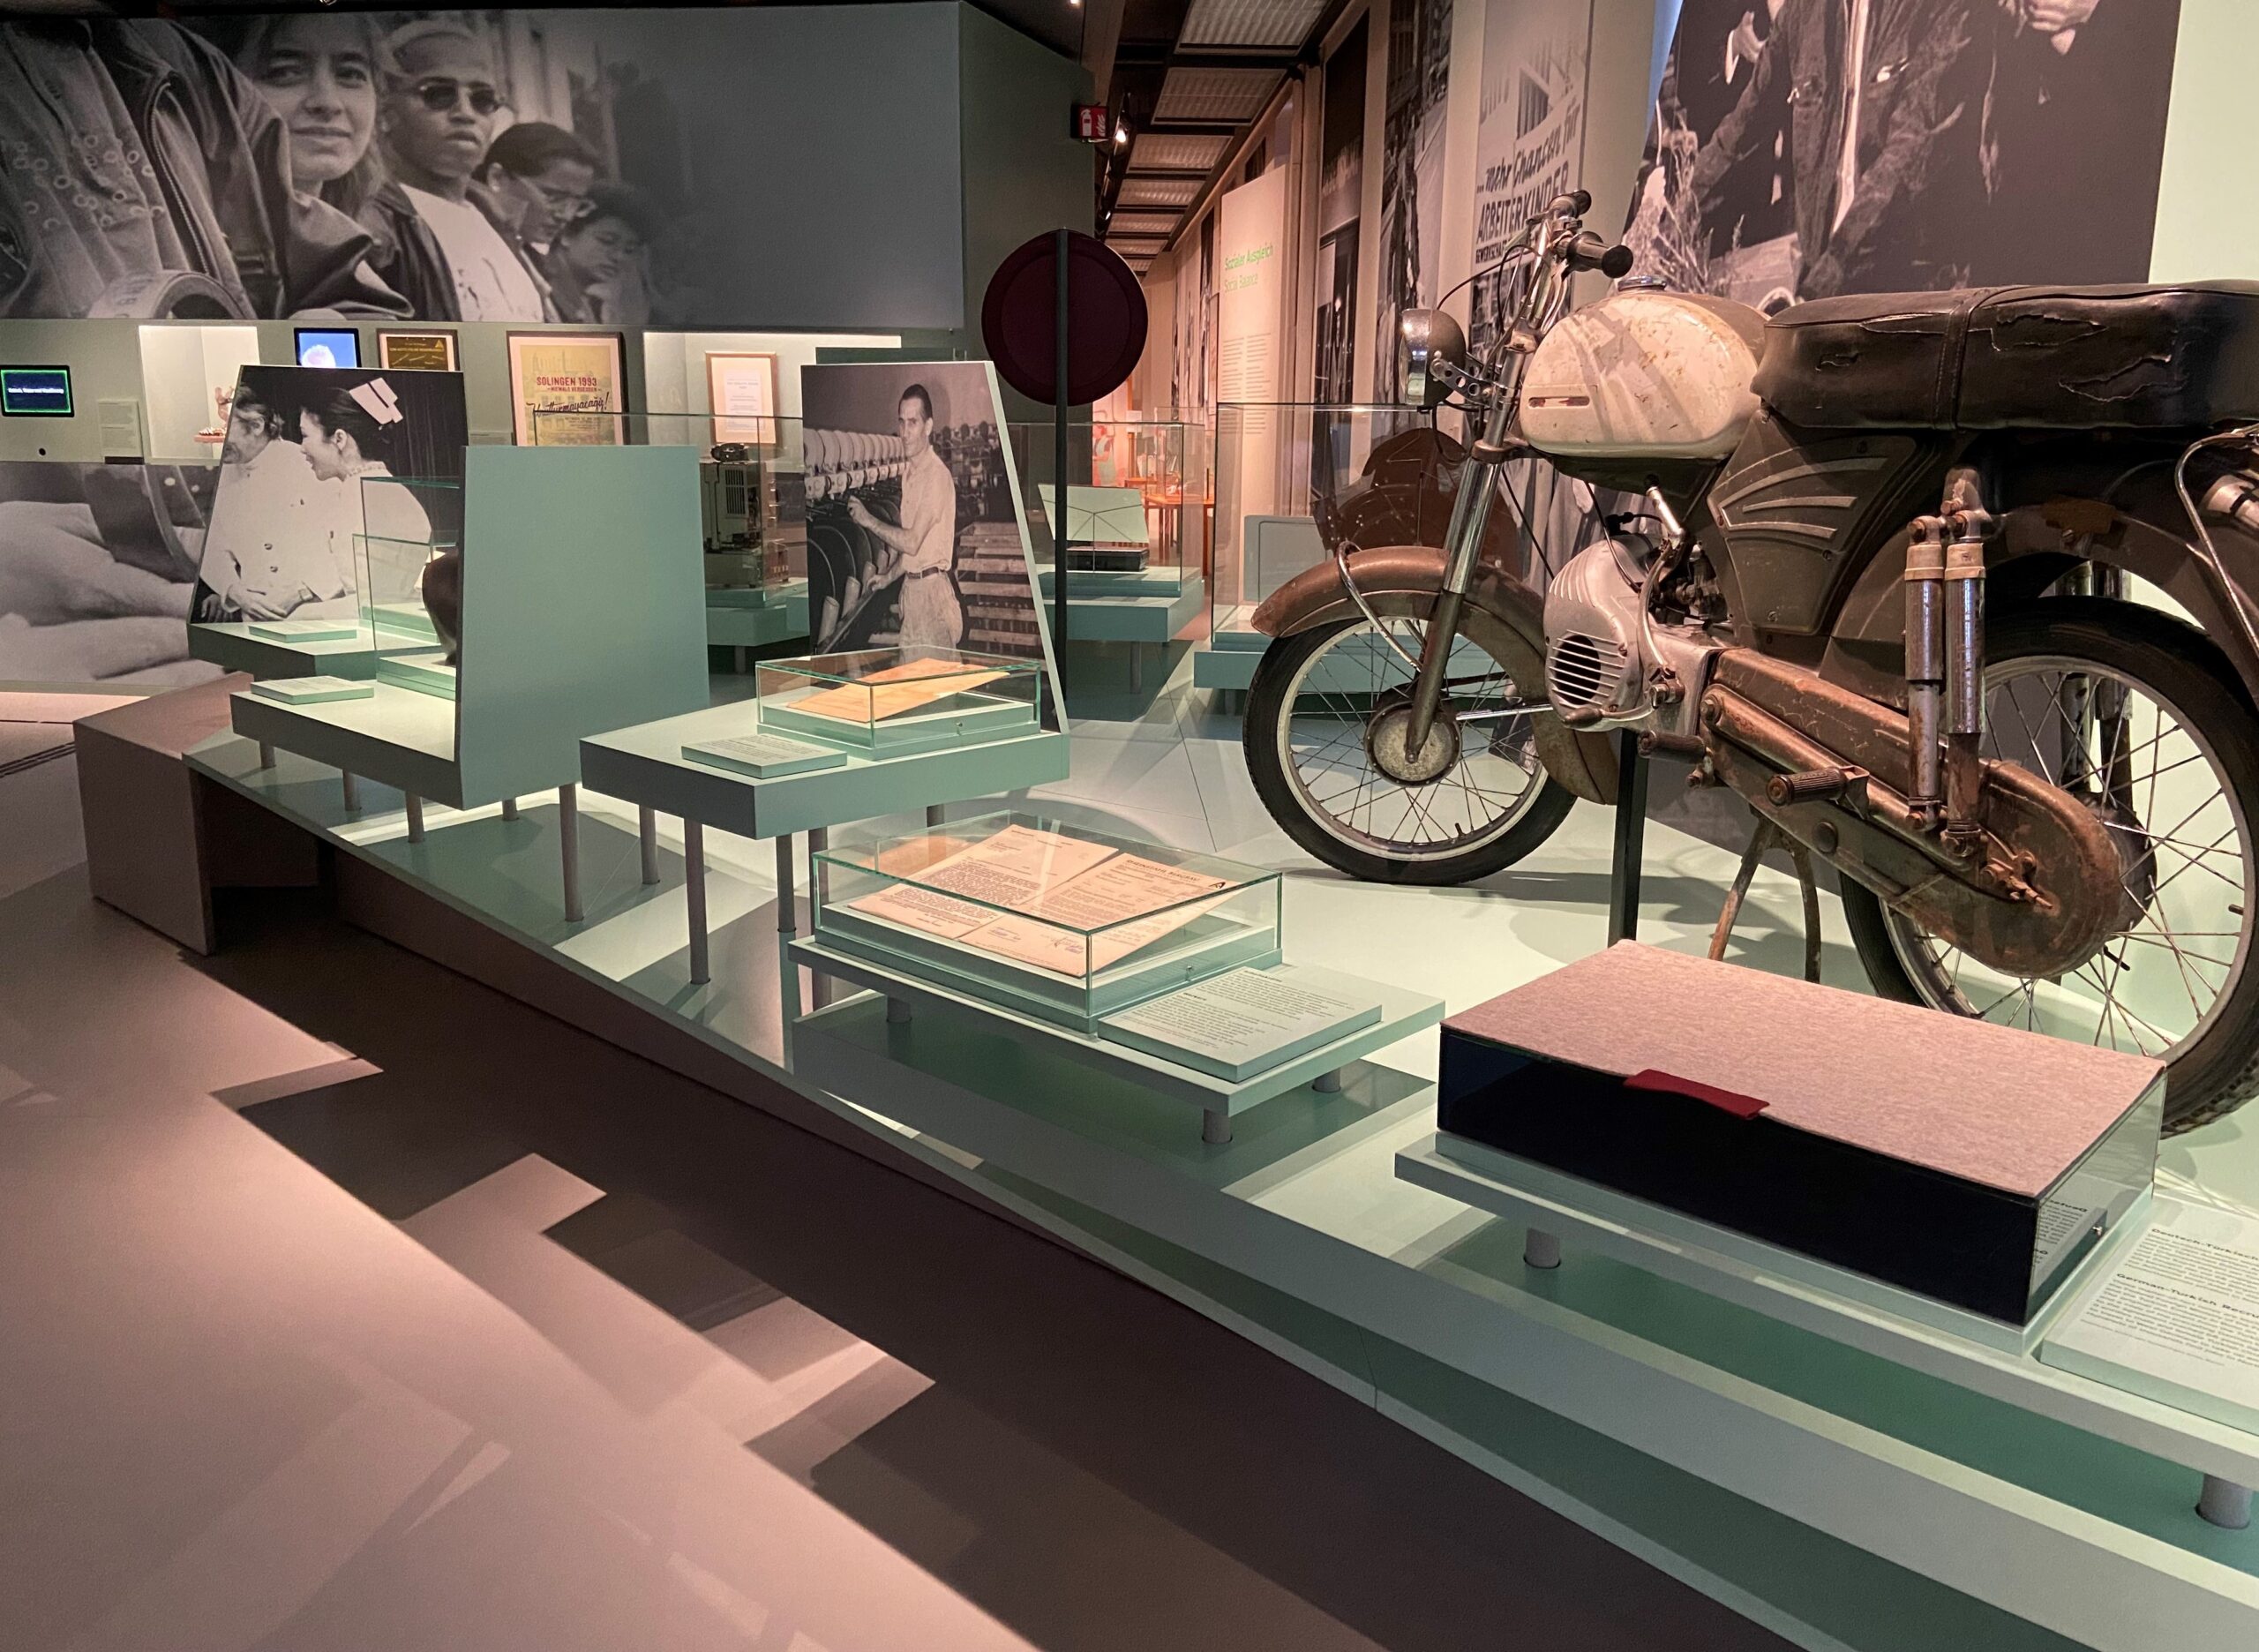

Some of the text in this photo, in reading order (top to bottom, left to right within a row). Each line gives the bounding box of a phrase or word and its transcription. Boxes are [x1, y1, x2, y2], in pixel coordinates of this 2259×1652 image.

[1512, 123, 1562, 189] Chancen
[1562, 95, 1581, 154] für
[537, 376, 597, 387] SOLINGEN 1993
[2116, 1272, 2217, 1306] German-Turkish
